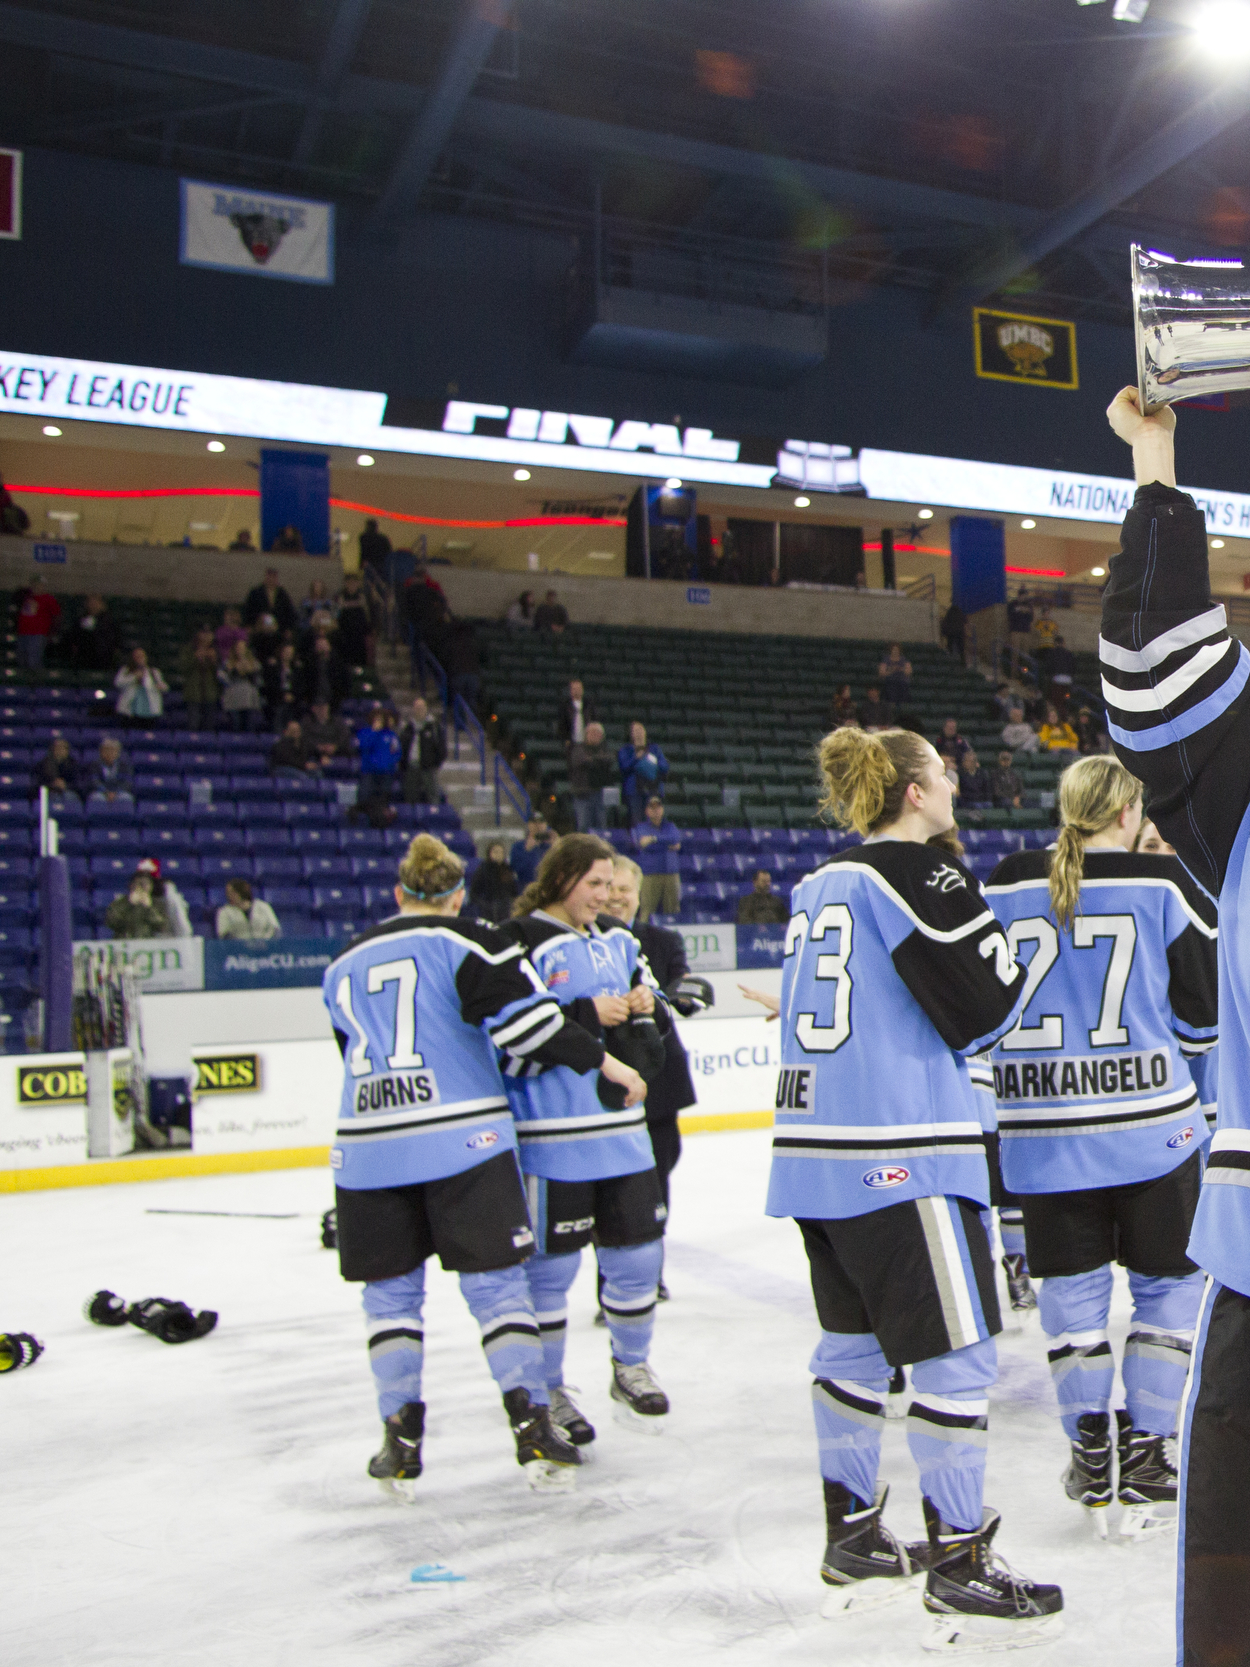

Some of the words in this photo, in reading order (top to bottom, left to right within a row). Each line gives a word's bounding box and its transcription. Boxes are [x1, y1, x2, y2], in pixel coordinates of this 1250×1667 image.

[0, 365, 59, 401] KEY
[66, 373, 194, 416] LEAGUE
[978, 930, 1020, 986] 2
[1003, 913, 1138, 1051] 27
[336, 956, 424, 1078] 17
[357, 1075, 433, 1113] BURNS
[993, 1052, 1169, 1099] DARKANGELO
